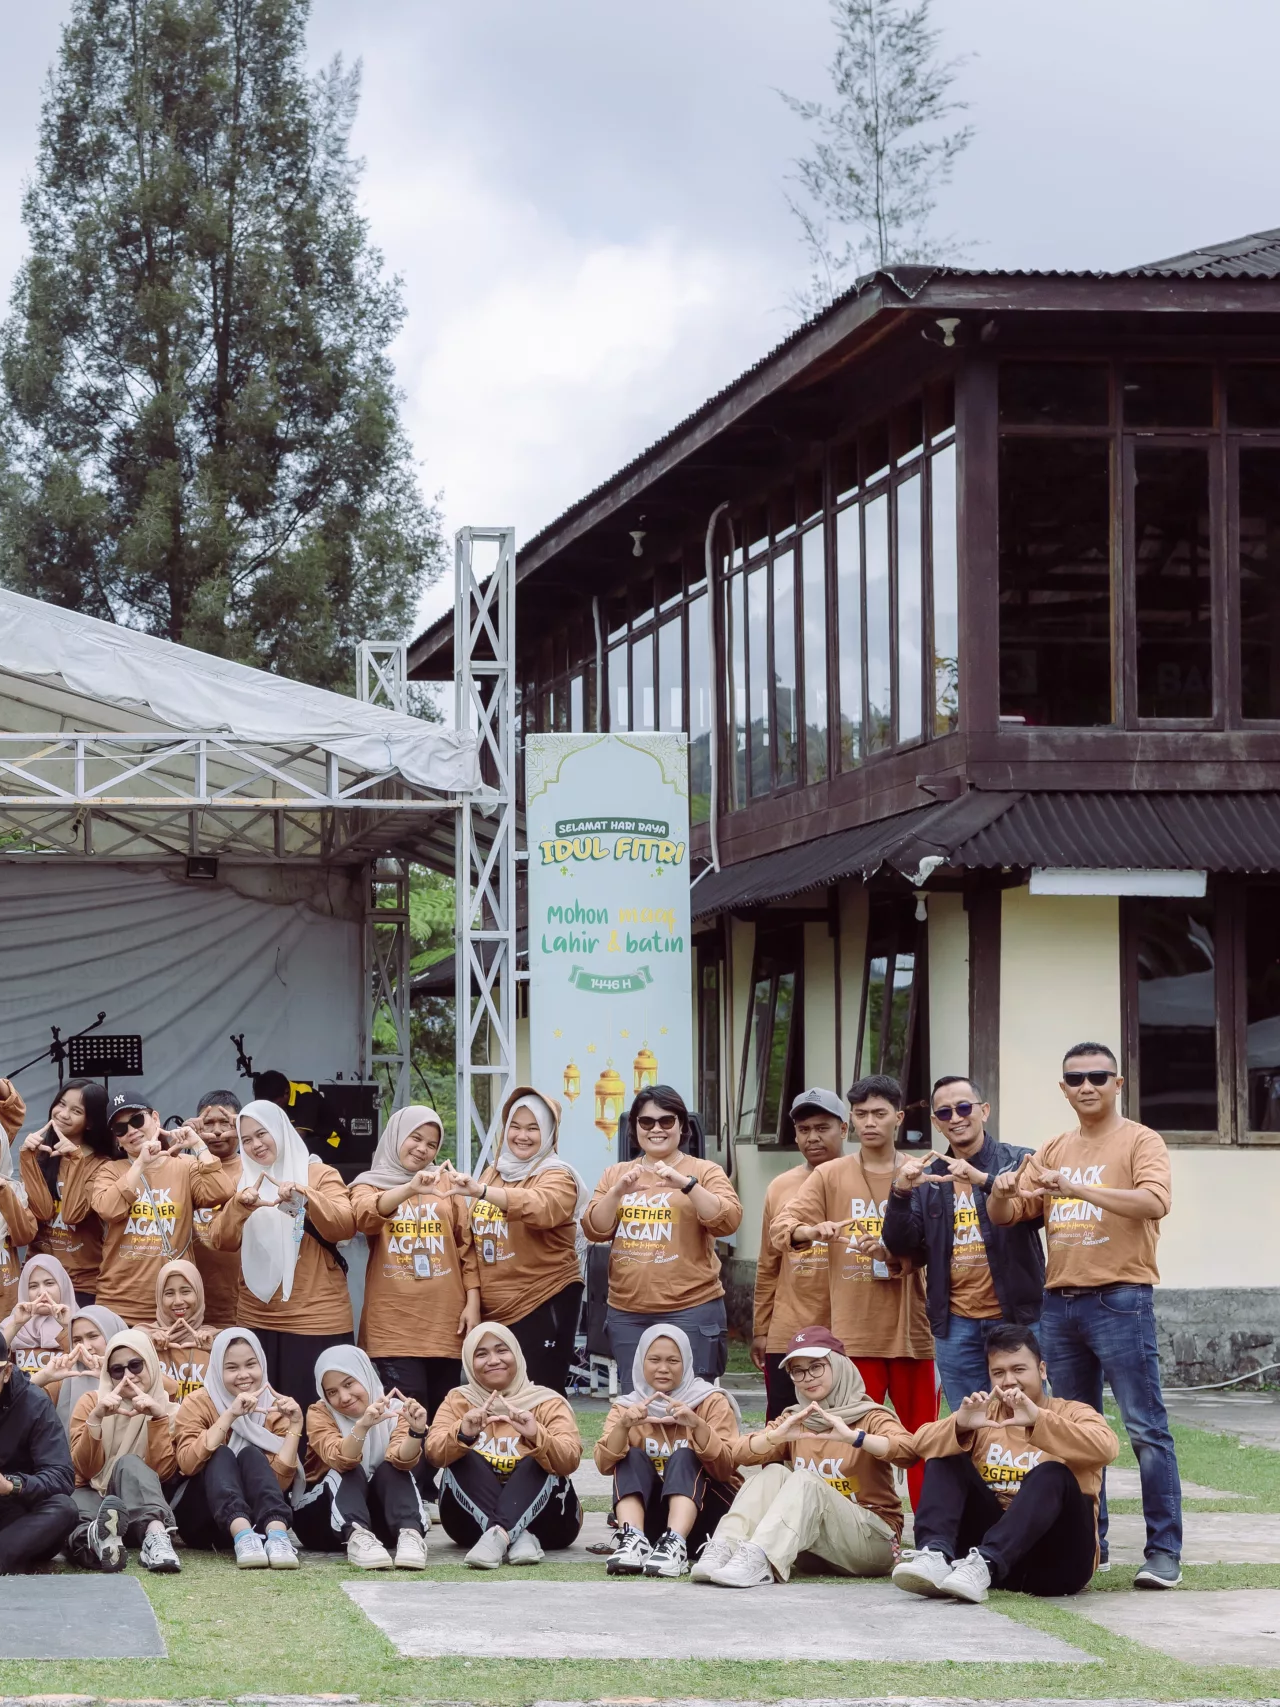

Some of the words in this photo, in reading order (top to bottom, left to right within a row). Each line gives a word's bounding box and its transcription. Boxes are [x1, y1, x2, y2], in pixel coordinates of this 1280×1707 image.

[559, 821, 607, 834] SELAMAT
[611, 821, 635, 831] HARI
[638, 822, 666, 835] RAYA
[539, 837, 610, 865] IDUL
[614, 837, 686, 865] FITRI
[547, 897, 609, 925] Mohon
[619, 907, 677, 935] maaf
[541, 931, 600, 954] Lahir
[607, 929, 622, 953] &
[626, 930, 684, 953] batin
[591, 978, 620, 990] 1446
[622, 979, 632, 989] H
[1060, 1165, 1106, 1186] BACK
[622, 1192, 673, 1208] BACK
[851, 1198, 888, 1219] BAC
[1049, 1200, 1103, 1222] AGAIN
[389, 1222, 442, 1233] 2GETHER
[615, 1219, 672, 1241] AGAIN
[388, 1235, 445, 1254] AGAIN
[986, 1443, 1043, 1470] BACK
[794, 1457, 846, 1479] BACK
[982, 1465, 1026, 1481] 2GETH
